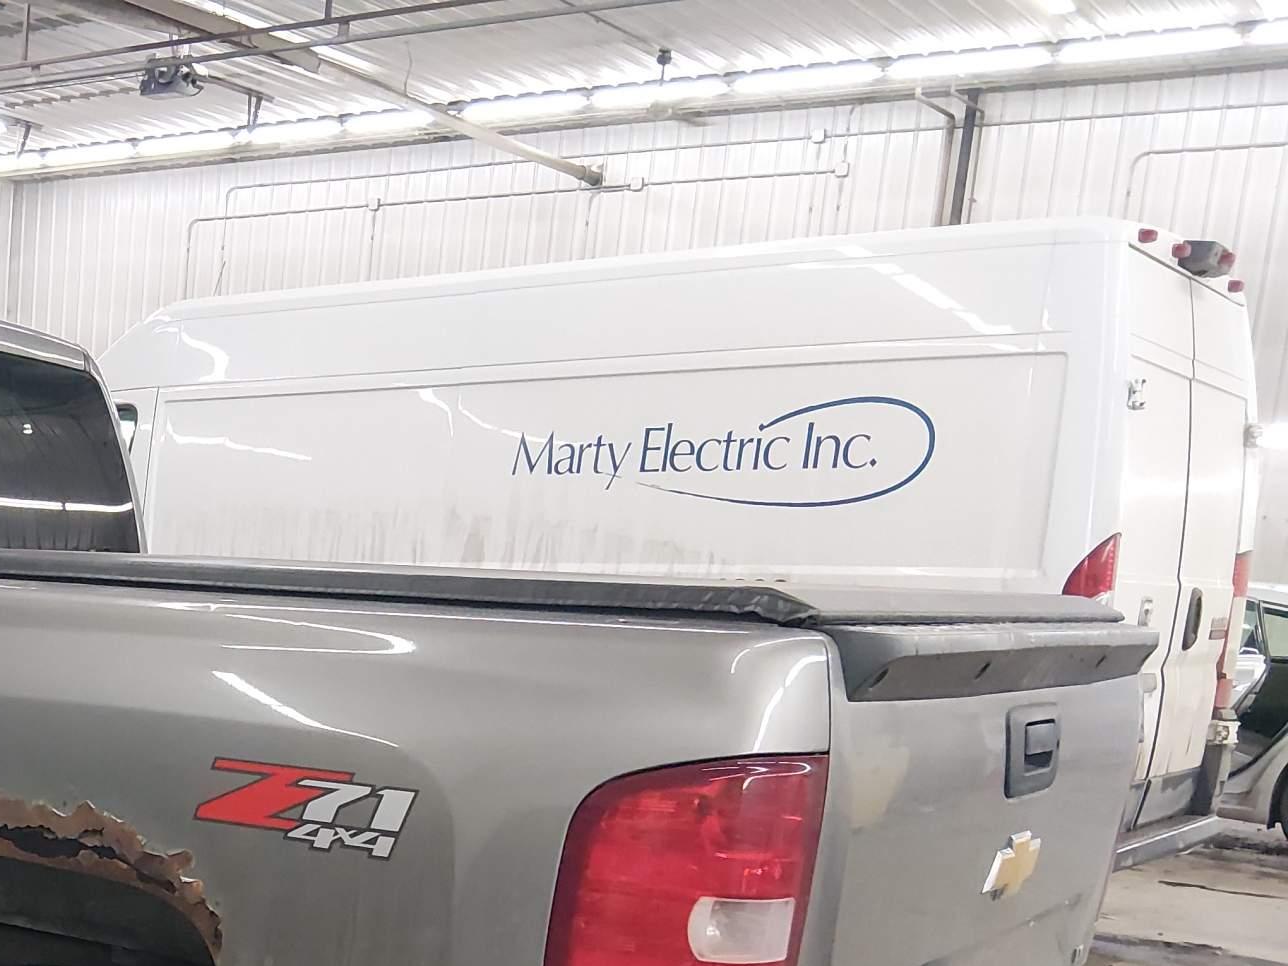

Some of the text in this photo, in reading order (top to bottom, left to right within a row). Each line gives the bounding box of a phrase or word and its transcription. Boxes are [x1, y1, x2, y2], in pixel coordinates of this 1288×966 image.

[511, 421, 877, 491] Marty Electric Inc.
[194, 756, 419, 834] Z71
